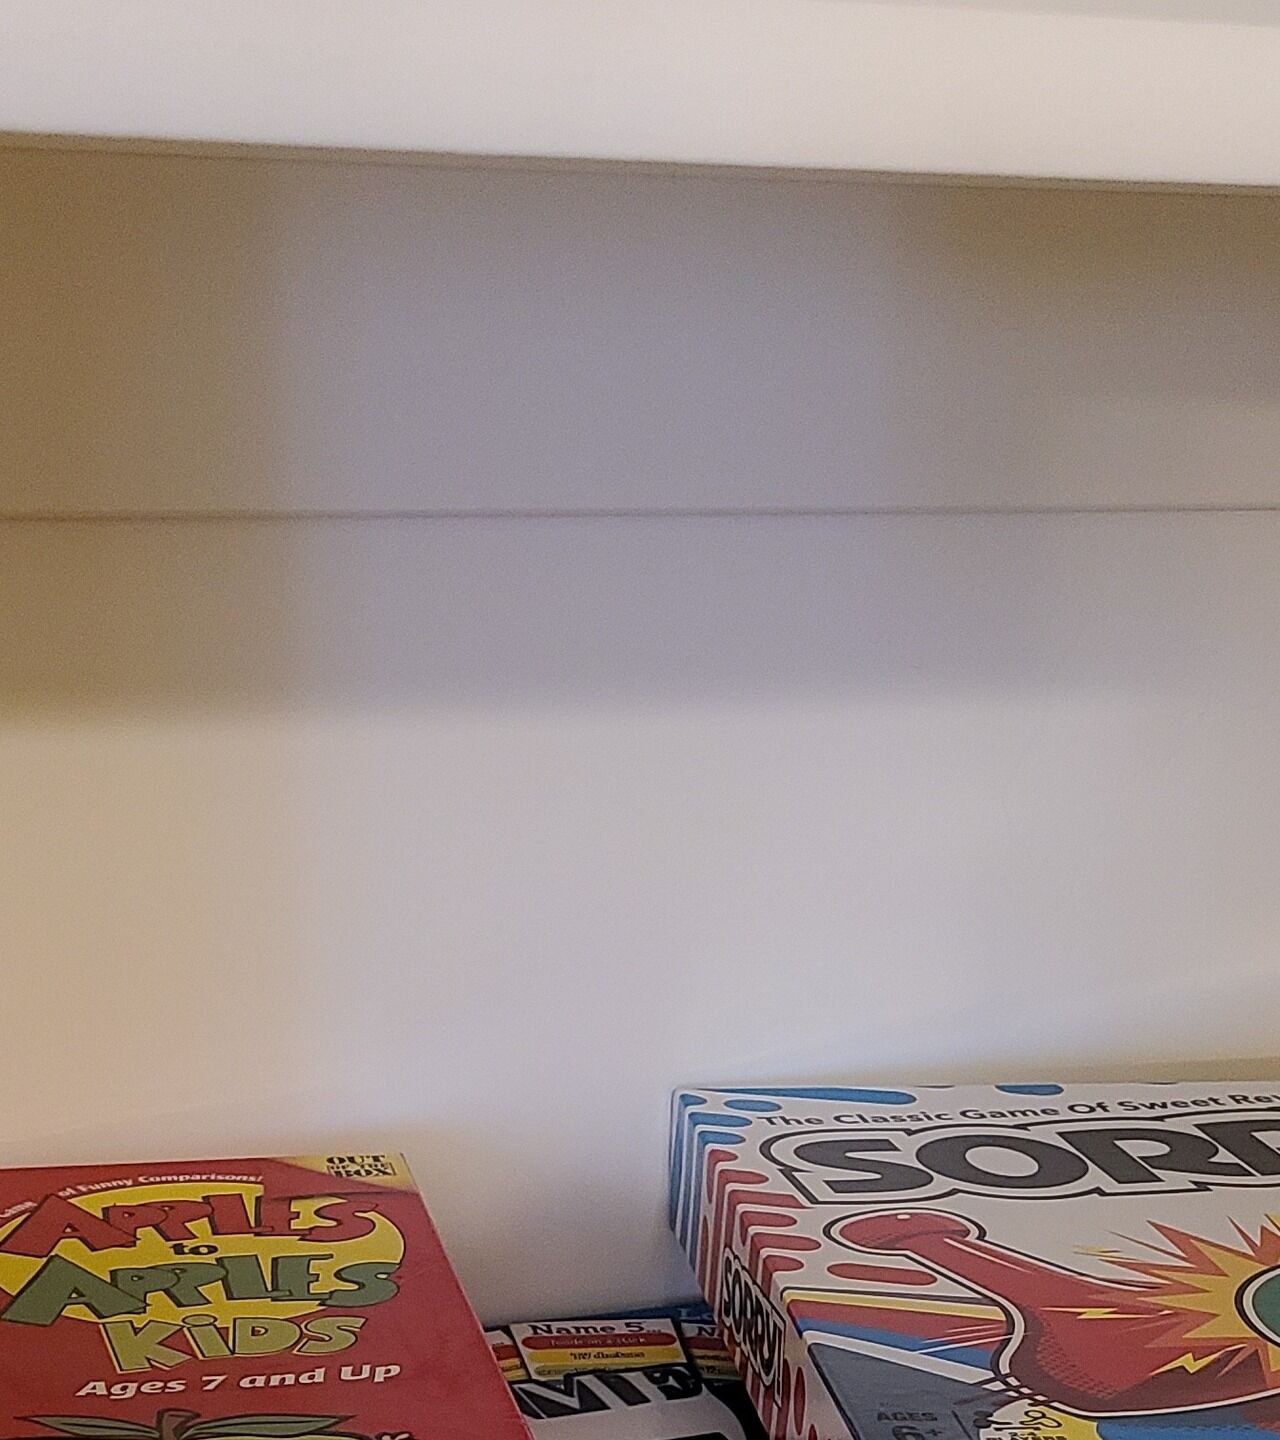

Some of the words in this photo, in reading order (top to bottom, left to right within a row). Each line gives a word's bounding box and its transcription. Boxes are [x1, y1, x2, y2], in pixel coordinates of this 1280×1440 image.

[756, 1113, 826, 1130] The
[832, 1108, 955, 1127] Classic
[958, 1104, 1060, 1122] Game
[1080, 1099, 1111, 1115] Of
[1116, 1094, 1227, 1114] Sweet
[77, 1175, 134, 1193] Funny
[137, 1172, 264, 1185] Comparisons!
[169, 1241, 218, 1257] to
[528, 1323, 617, 1336] Name
[721, 1251, 785, 1399] SORRY!
[74, 1374, 185, 1400] Ages
[200, 1374, 230, 1393] 7
[239, 1367, 326, 1389] and
[338, 1363, 402, 1386] Up
[876, 1411, 938, 1422] AGES
